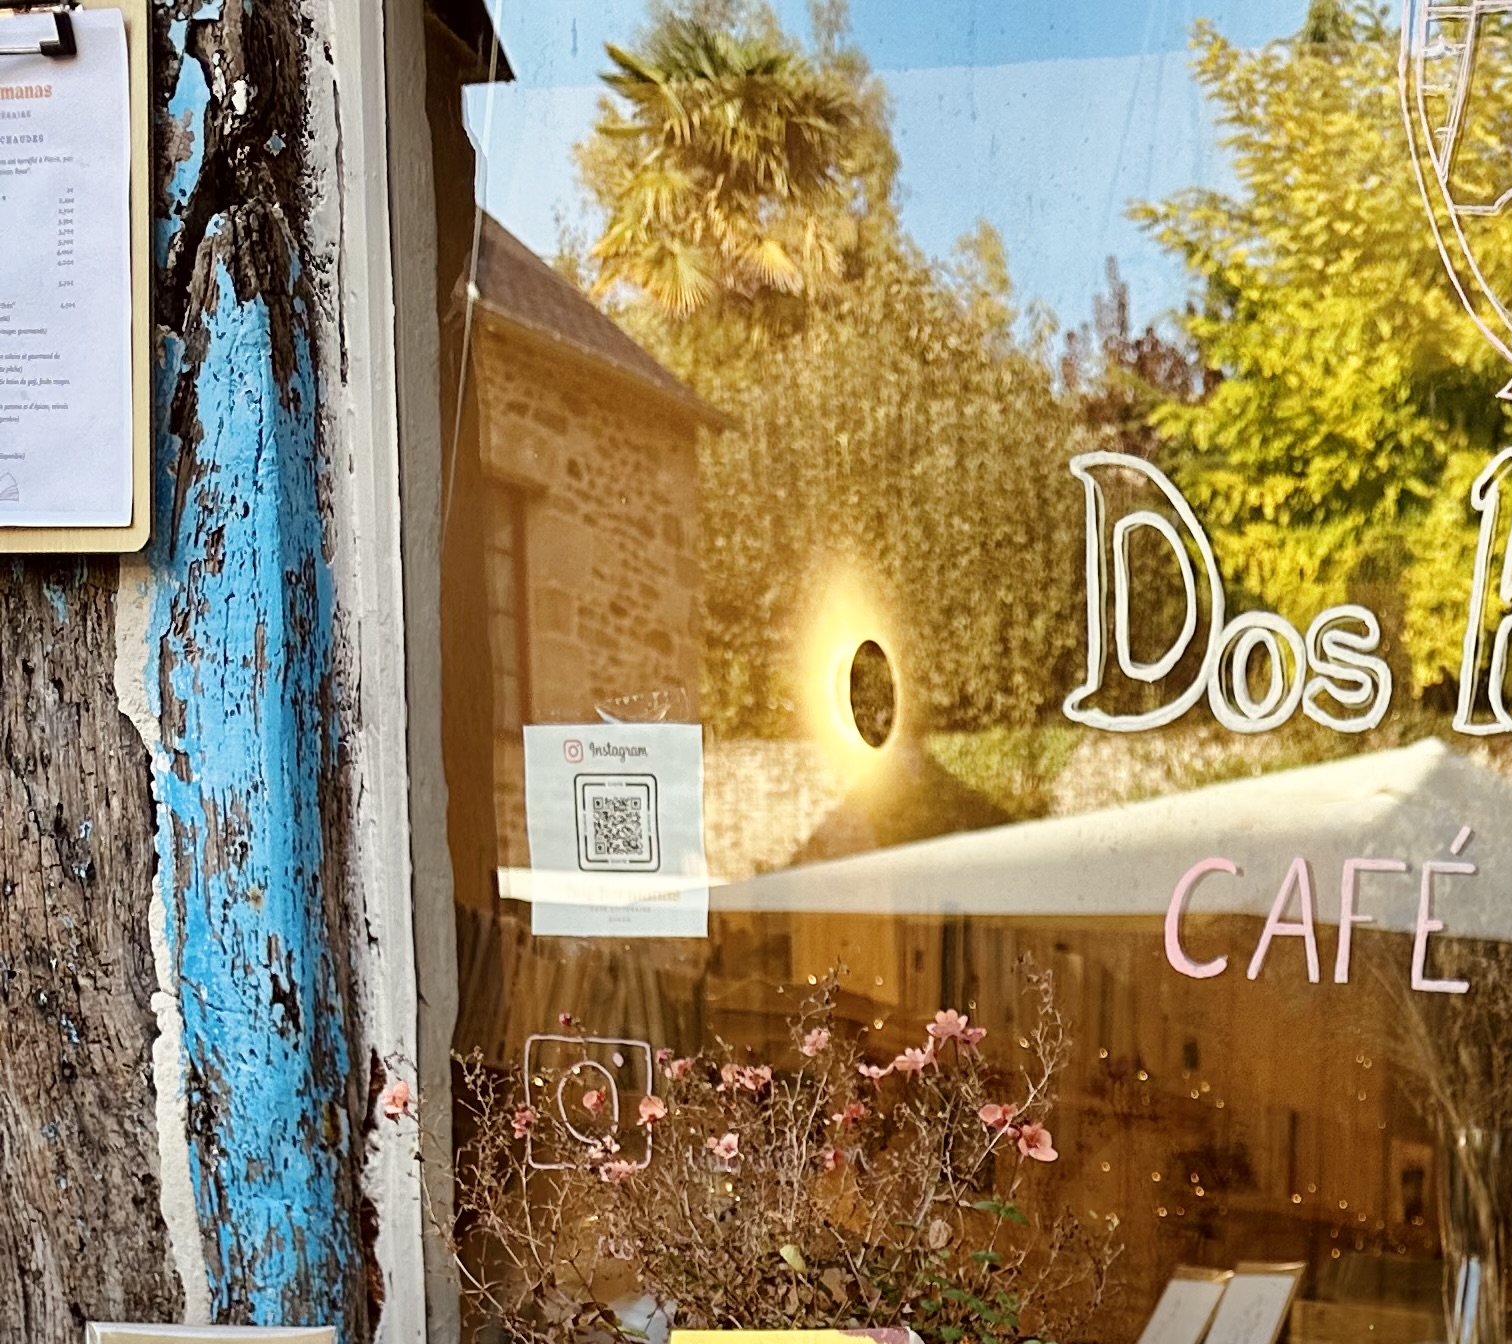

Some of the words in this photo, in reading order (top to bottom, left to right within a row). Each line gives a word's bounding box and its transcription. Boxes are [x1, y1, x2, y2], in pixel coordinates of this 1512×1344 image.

[1063, 450, 1393, 733] Dos
[588, 742, 649, 763] Instagram
[1164, 826, 1478, 994] CAFÉ
